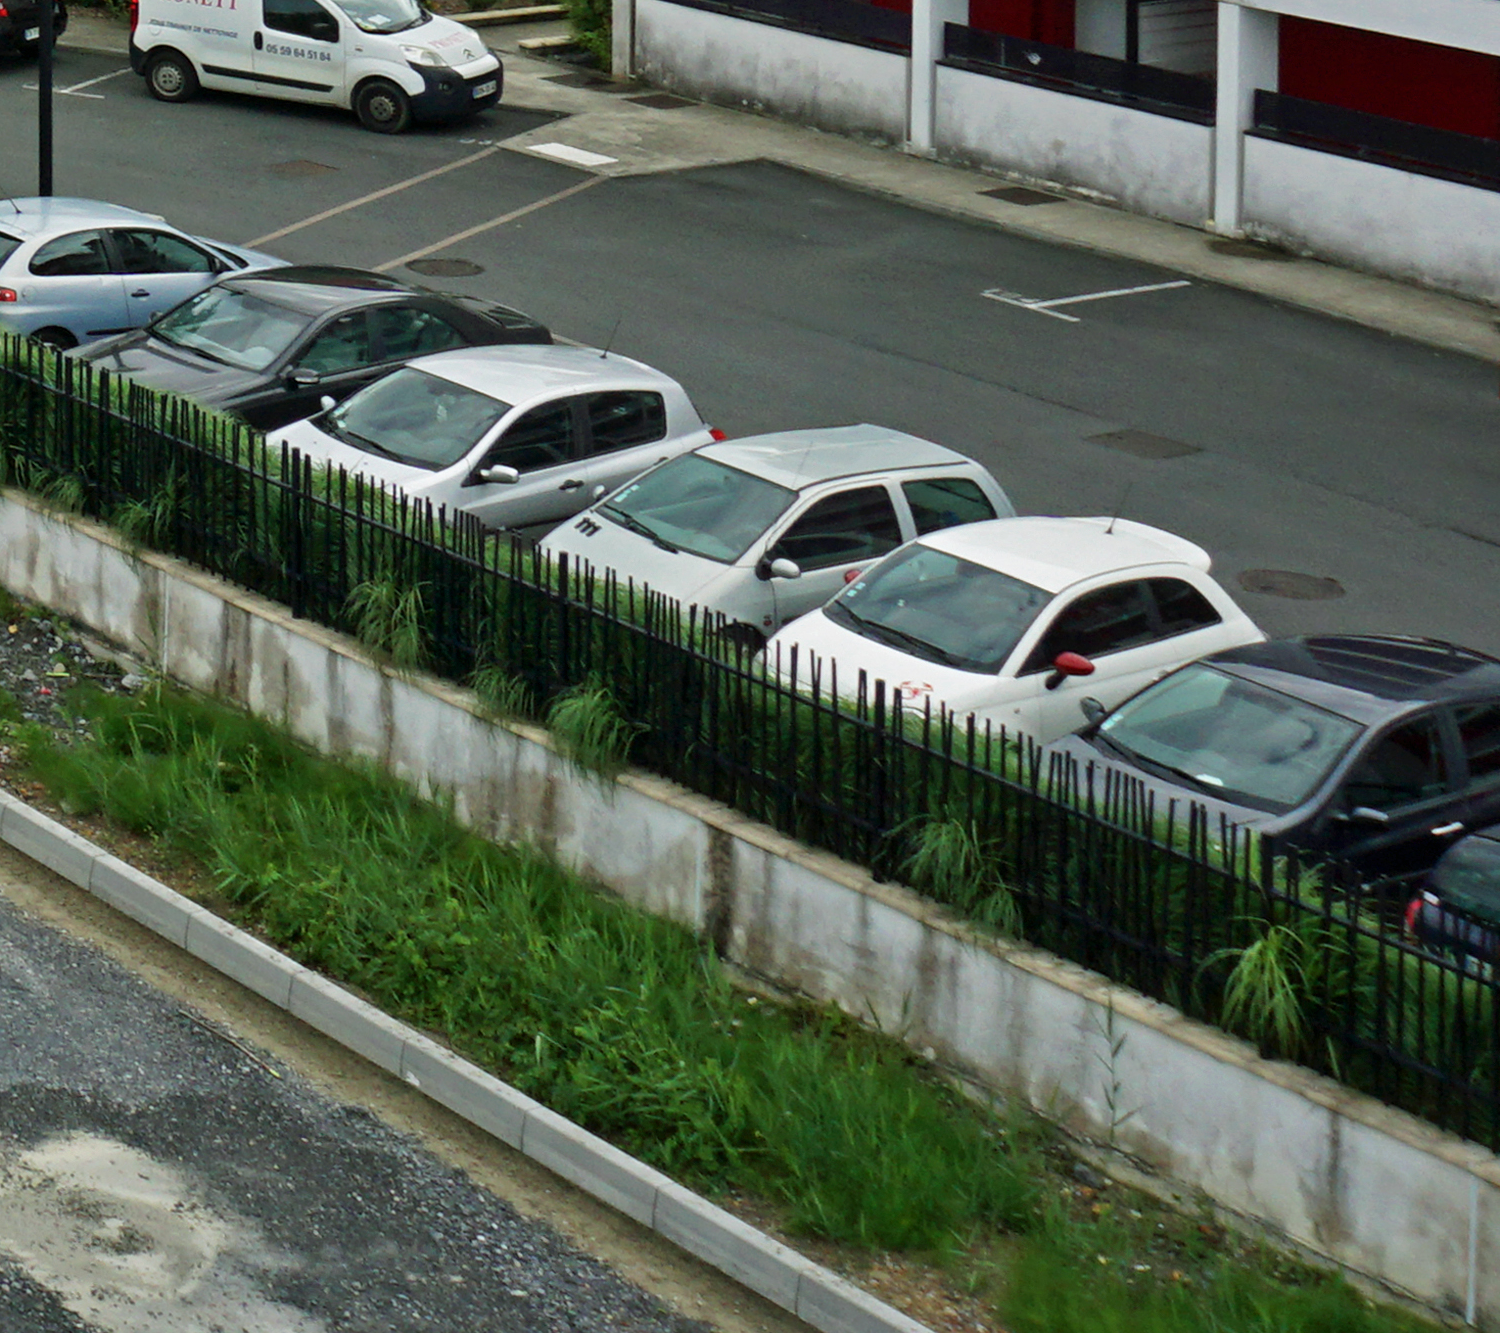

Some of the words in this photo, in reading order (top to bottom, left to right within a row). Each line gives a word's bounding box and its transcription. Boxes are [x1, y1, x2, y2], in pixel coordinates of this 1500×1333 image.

[266, 43, 278, 54] 05
[280, 44, 292, 56] 59
[293, 46, 306, 58] 64
[307, 48, 318, 60] 51
